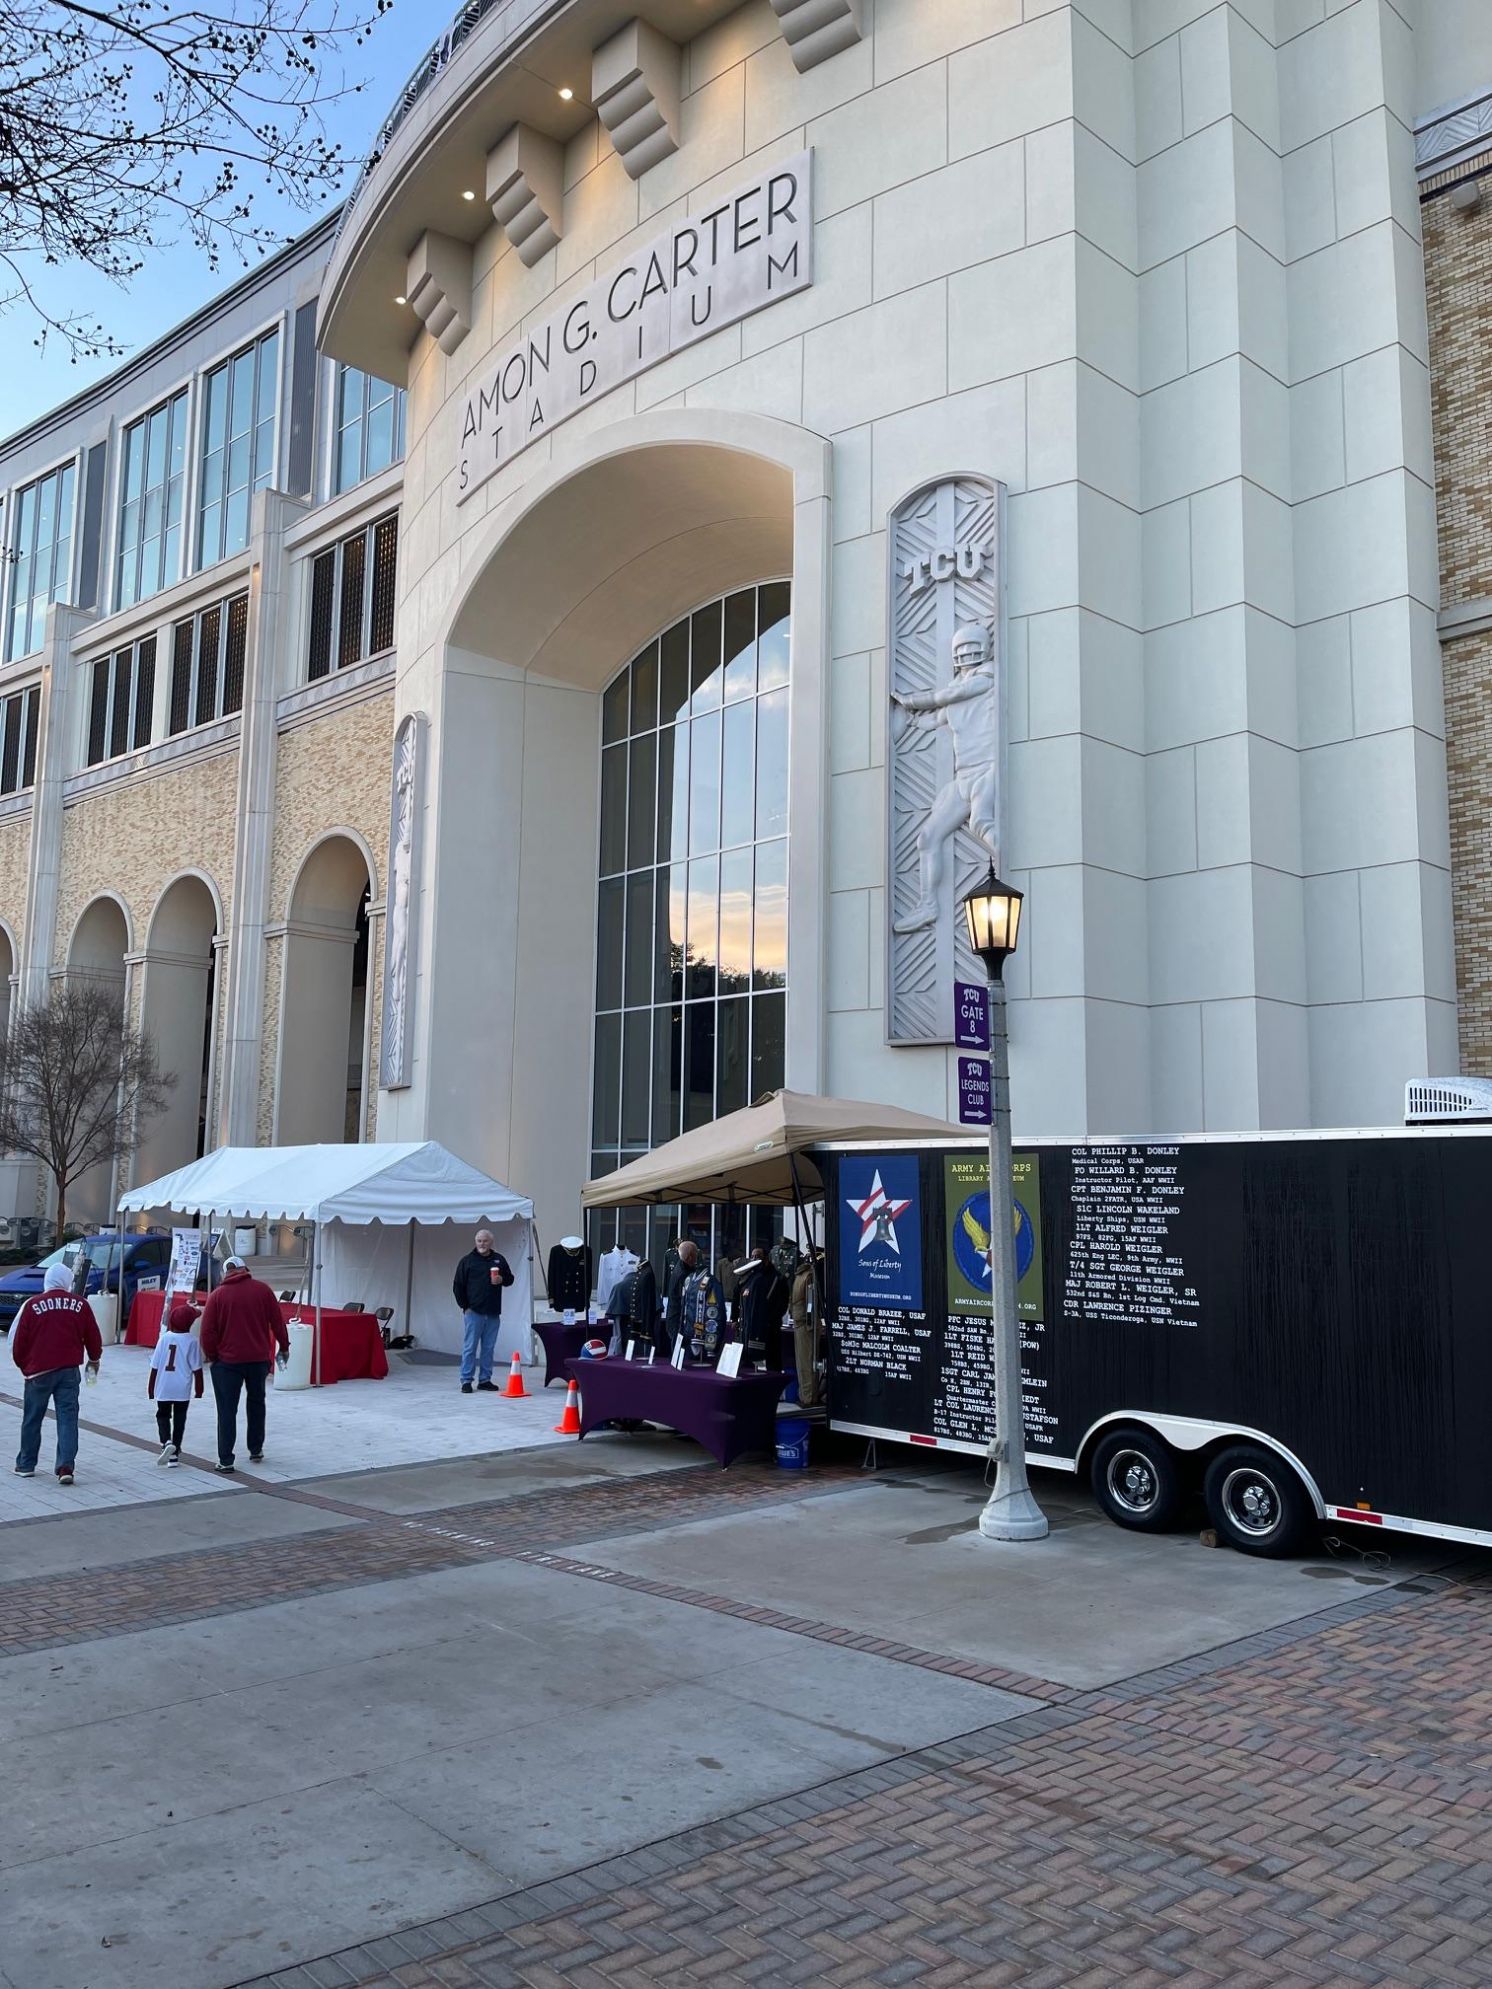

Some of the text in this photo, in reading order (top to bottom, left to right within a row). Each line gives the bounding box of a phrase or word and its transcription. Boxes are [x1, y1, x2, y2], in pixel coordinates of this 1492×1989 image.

[461, 172, 798, 449] AMON G. CARTER
[459, 240, 798, 490] STADIUM
[903, 544, 985, 596] TCU
[964, 988, 980, 1003] TCU
[961, 1005, 984, 1020] GATE
[970, 1020, 976, 1033] 8
[967, 1062, 983, 1077] TCU
[961, 1079, 990, 1092] LEGENDS
[968, 1094, 984, 1105] CLUB
[1147, 1147, 1179, 1155] DONLEY
[1012, 1164, 1032, 1172] RPS
[1101, 1158, 1124, 1166] Corps,
[1152, 1187, 1184, 1195] DONLEY
[1137, 1206, 1180, 1215] WAKELAND
[1077, 1215, 1103, 1223] Liberty
[1095, 1225, 1126, 1233] ALFRED
[1131, 1226, 1169, 1234] WEIGLER
[1070, 1241, 1163, 1253] CPL HAROLD WEIGLER
[858, 1259, 902, 1272] Sons of Liberty
[1142, 1256, 1162, 1264] Army,
[1070, 1261, 1085, 1269] T/4
[1110, 1264, 1141, 1273] GEORGE
[1146, 1266, 1184, 1276] WEIGLER
[1119, 1275, 1150, 1283] Division
[1086, 1281, 1116, 1290] ROBERT
[1137, 1285, 1178, 1295] WEIGLER,
[1185, 1288, 1197, 1296] SR
[32, 1297, 83, 1315] SOONERS
[1134, 1295, 1146, 1303] Log
[1170, 1298, 1199, 1306] Vietnam
[1064, 1300, 1172, 1315] CDR LAWRENCE PIZINGER
[853, 1308, 875, 1316] DONALD
[910, 1312, 926, 1320] USAF
[1102, 1313, 1147, 1323] Ticonderoga,
[1168, 1318, 1198, 1327] Vietnam
[948, 1316, 960, 1324] PFC
[965, 1317, 987, 1326] JESUS
[1035, 1324, 1045, 1332] JR
[847, 1324, 865, 1332] JAMES
[880, 1327, 910, 1336] FARRELL,
[915, 1329, 932, 1337] USAF
[961, 1335, 983, 1343] FISKE
[862, 1342, 890, 1351] MALCOLM
[893, 1344, 921, 1354] COALTER
[165, 1344, 177, 1372] 1
[951, 1351, 964, 1359] 1LT
[968, 1353, 985, 1361] REID
[846, 1357, 907, 1371] 2LT NORMAN BLACK
[941, 1367, 959, 1375] 1SGT
[962, 1370, 980, 1378] CARL
[946, 1385, 986, 1396] CPL HENRY
[934, 1399, 943, 1407] LT
[946, 1401, 960, 1410] COL
[946, 1394, 992, 1406] Quartermaster
[950, 1411, 982, 1422] Instructor
[934, 1417, 947, 1426] COL
[950, 1420, 968, 1430] GLEN
[972, 1423, 980, 1432] L.
[1034, 1433, 1054, 1444] USAF
